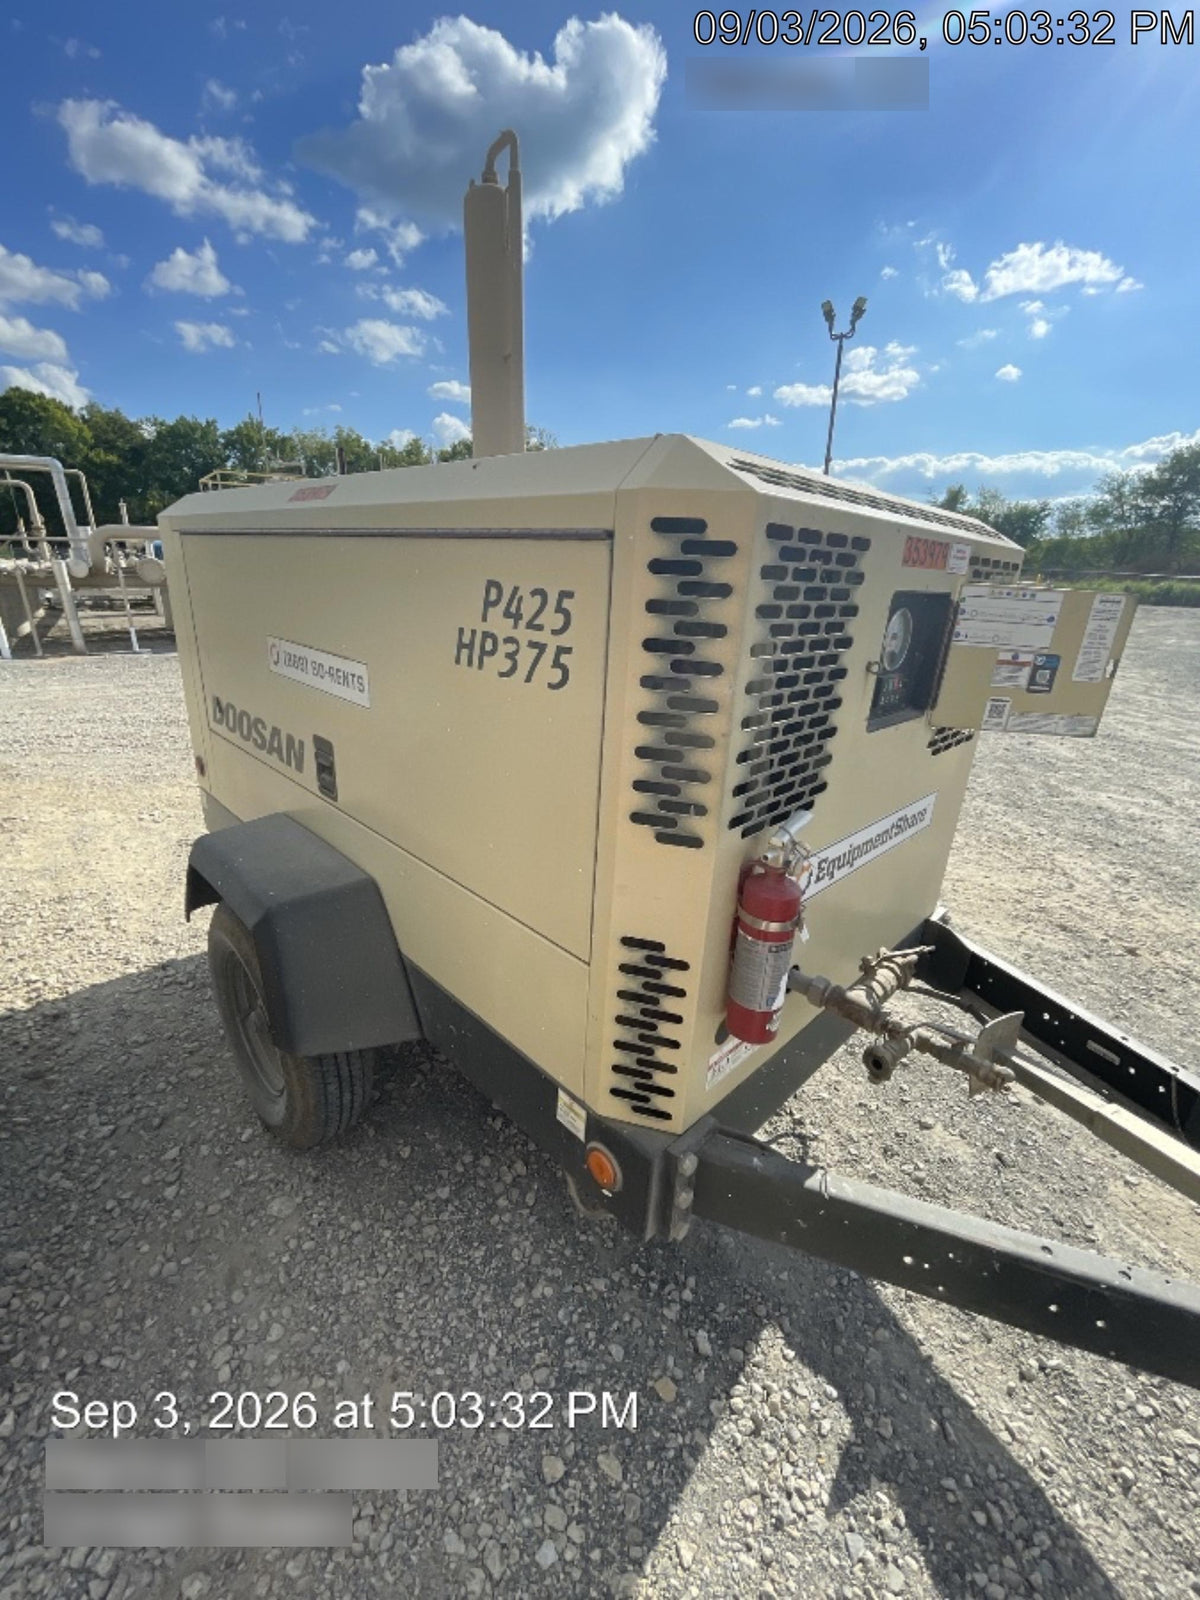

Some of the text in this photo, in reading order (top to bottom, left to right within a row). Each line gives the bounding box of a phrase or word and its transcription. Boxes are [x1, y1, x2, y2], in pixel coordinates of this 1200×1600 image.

[481, 579, 575, 636] P425
[454, 627, 573, 690] HP375
[212, 694, 305, 774] DOOSAN
[814, 807, 928, 884] EquipmentShare
